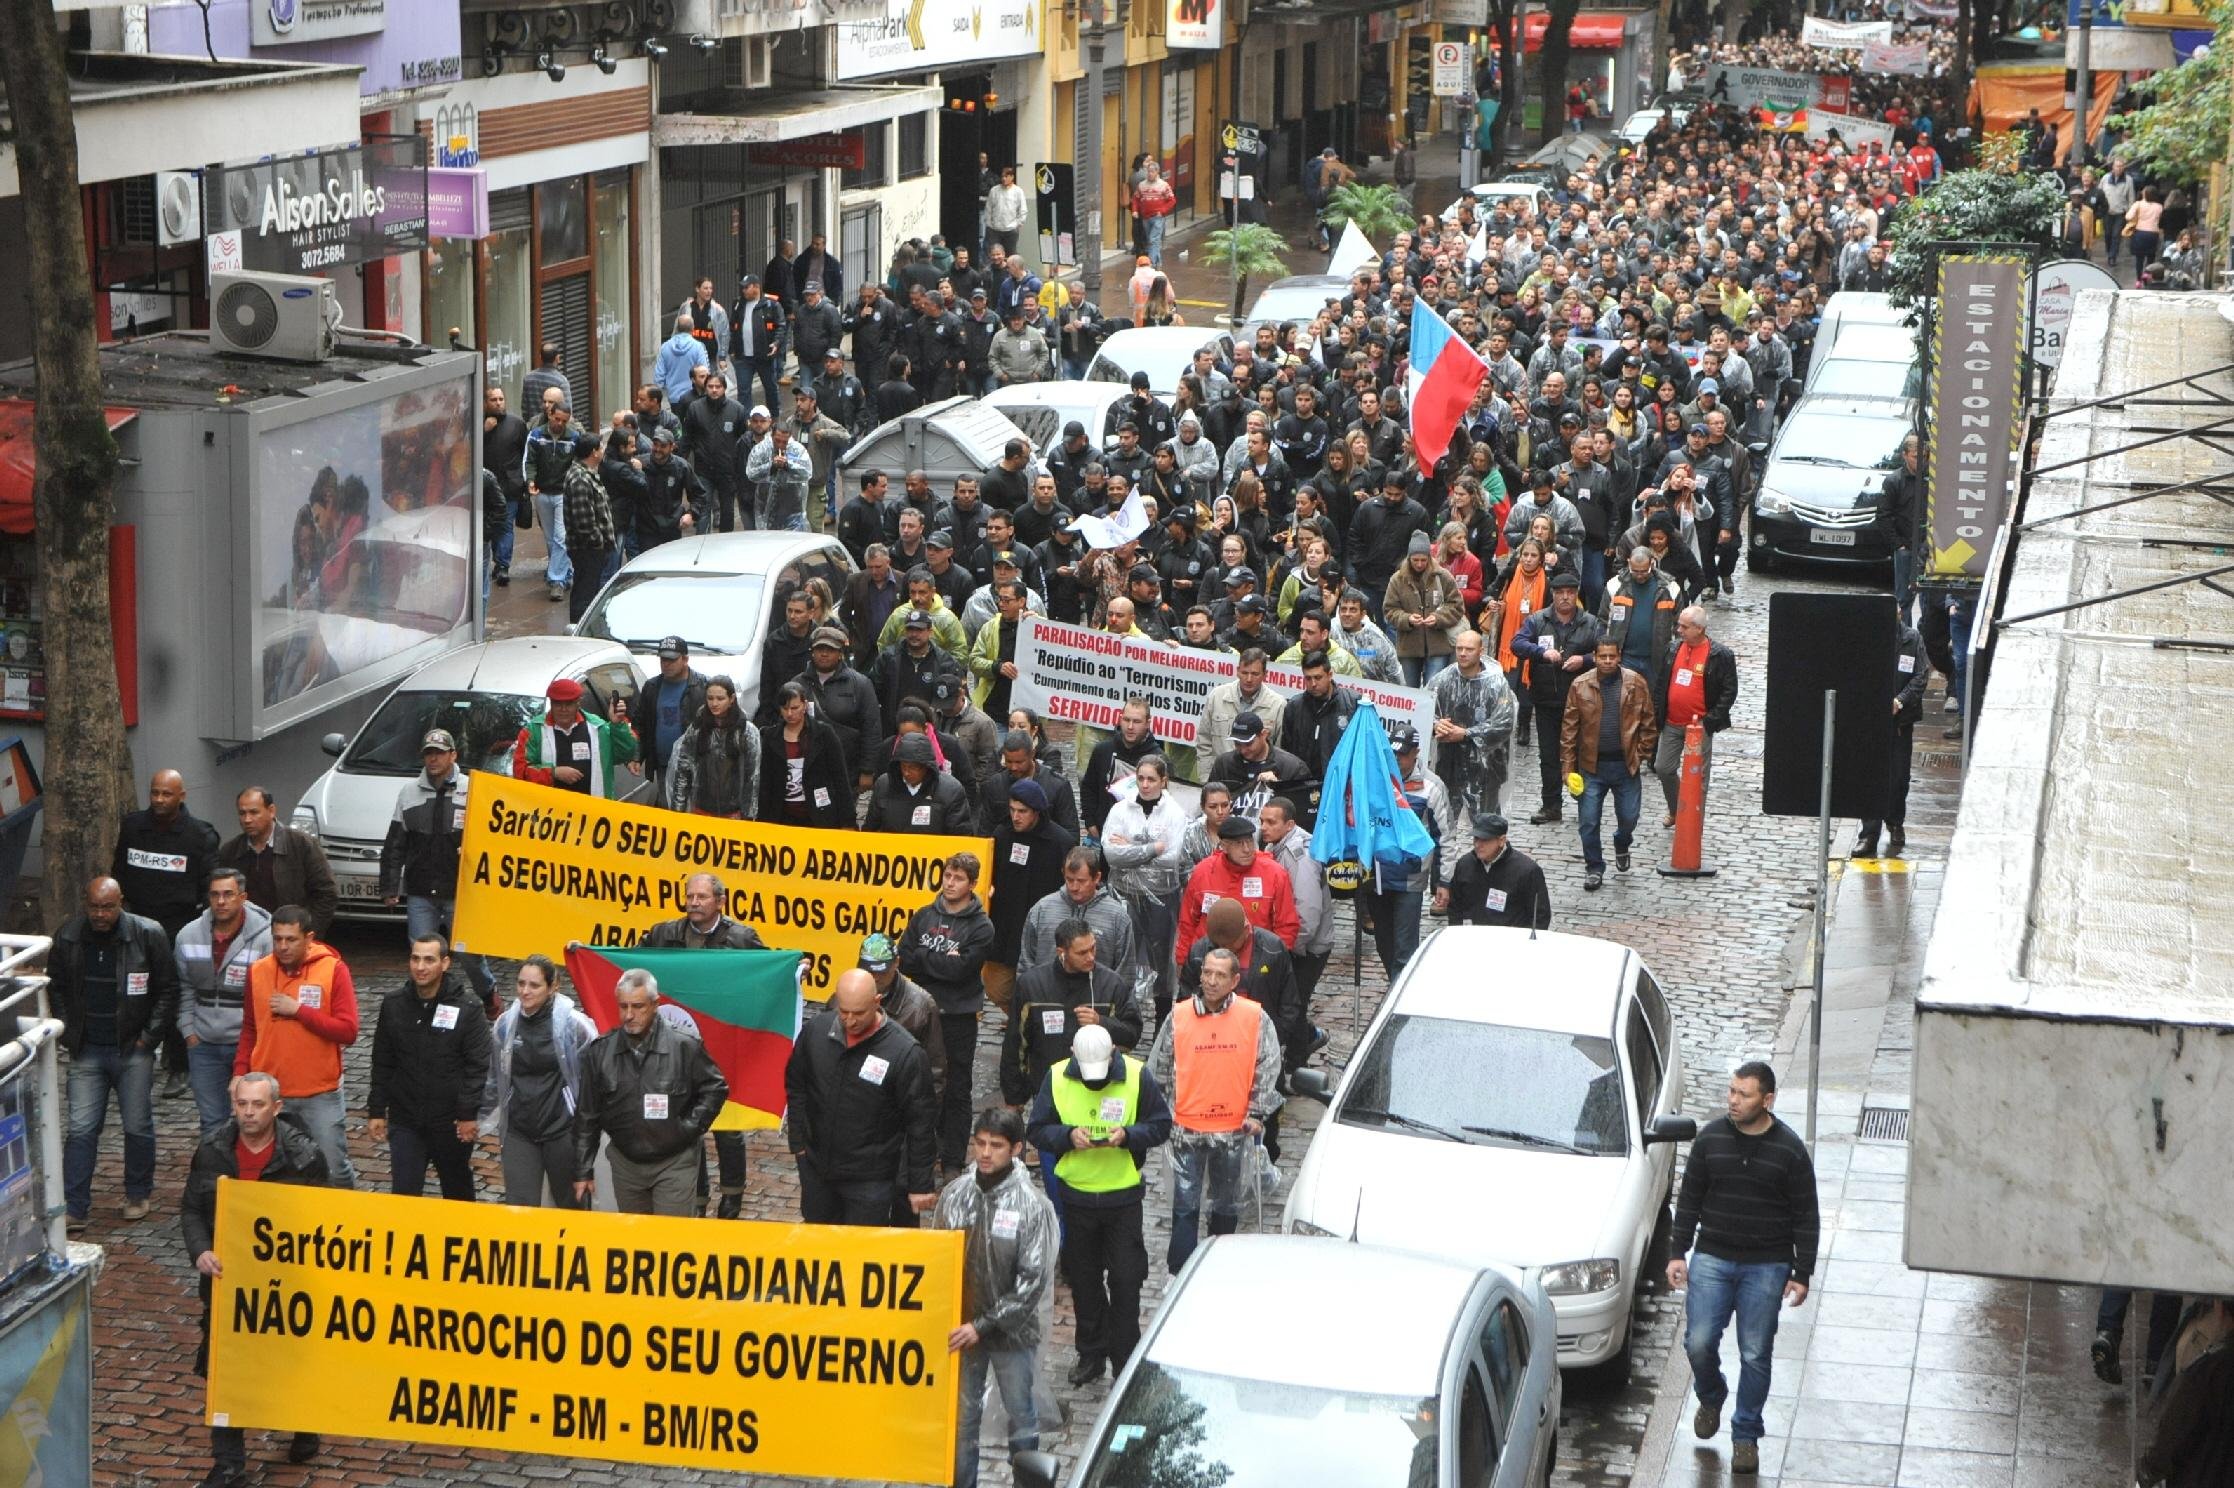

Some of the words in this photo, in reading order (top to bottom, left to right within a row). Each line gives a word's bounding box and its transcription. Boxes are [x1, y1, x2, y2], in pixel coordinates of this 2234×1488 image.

[1740, 72, 1810, 90] GOVERNADOR
[292, 228, 314, 249] HAIR
[317, 223, 351, 245] STYLIST
[384, 217, 426, 236] SEBASTIAN
[301, 243, 346, 270] 3072.5684
[2032, 327, 2061, 348] Ba
[1955, 284, 1996, 538] ESTACIONAMENTO
[1033, 623, 1123, 657] PARALISAÇÃO
[1124, 645, 1147, 661] POR
[1149, 649, 1215, 674] MELHORIAS
[1217, 661, 1234, 677] NO
[1098, 663, 1116, 680] ao
[1106, 686, 1120, 701] da
[1048, 694, 1124, 728] SERVIDO
[1151, 715, 1197, 743] NIDO
[488, 799, 573, 846] Sartóri
[575, 814, 588, 846] !
[592, 816, 612, 849] O
[616, 820, 667, 858] SEU
[674, 830, 796, 877] GOVERNO
[474, 851, 491, 886] A
[498, 854, 652, 913] SEGURANÇA
[658, 873, 766, 925] PÚICA
[774, 894, 826, 931] DOS
[252, 1216, 374, 1274] Sartóri
[384, 1230, 395, 1277] !
[404, 1233, 430, 1281] A
[442, 1228, 592, 1293] FAMILÍA
[604, 1247, 847, 1308] BRIGADIANA
[860, 1261, 926, 1312] DIZ
[232, 1278, 314, 1338] NÃO
[324, 1294, 376, 1343] AO
[388, 1302, 567, 1364] ARROCHO
[580, 1320, 632, 1369] DO
[645, 1325, 721, 1375] SEU
[734, 1331, 935, 1387] GOVERNO.
[388, 1375, 519, 1433] ABAMF
[552, 1393, 607, 1442] BM
[643, 1402, 760, 1454] BM/RS
